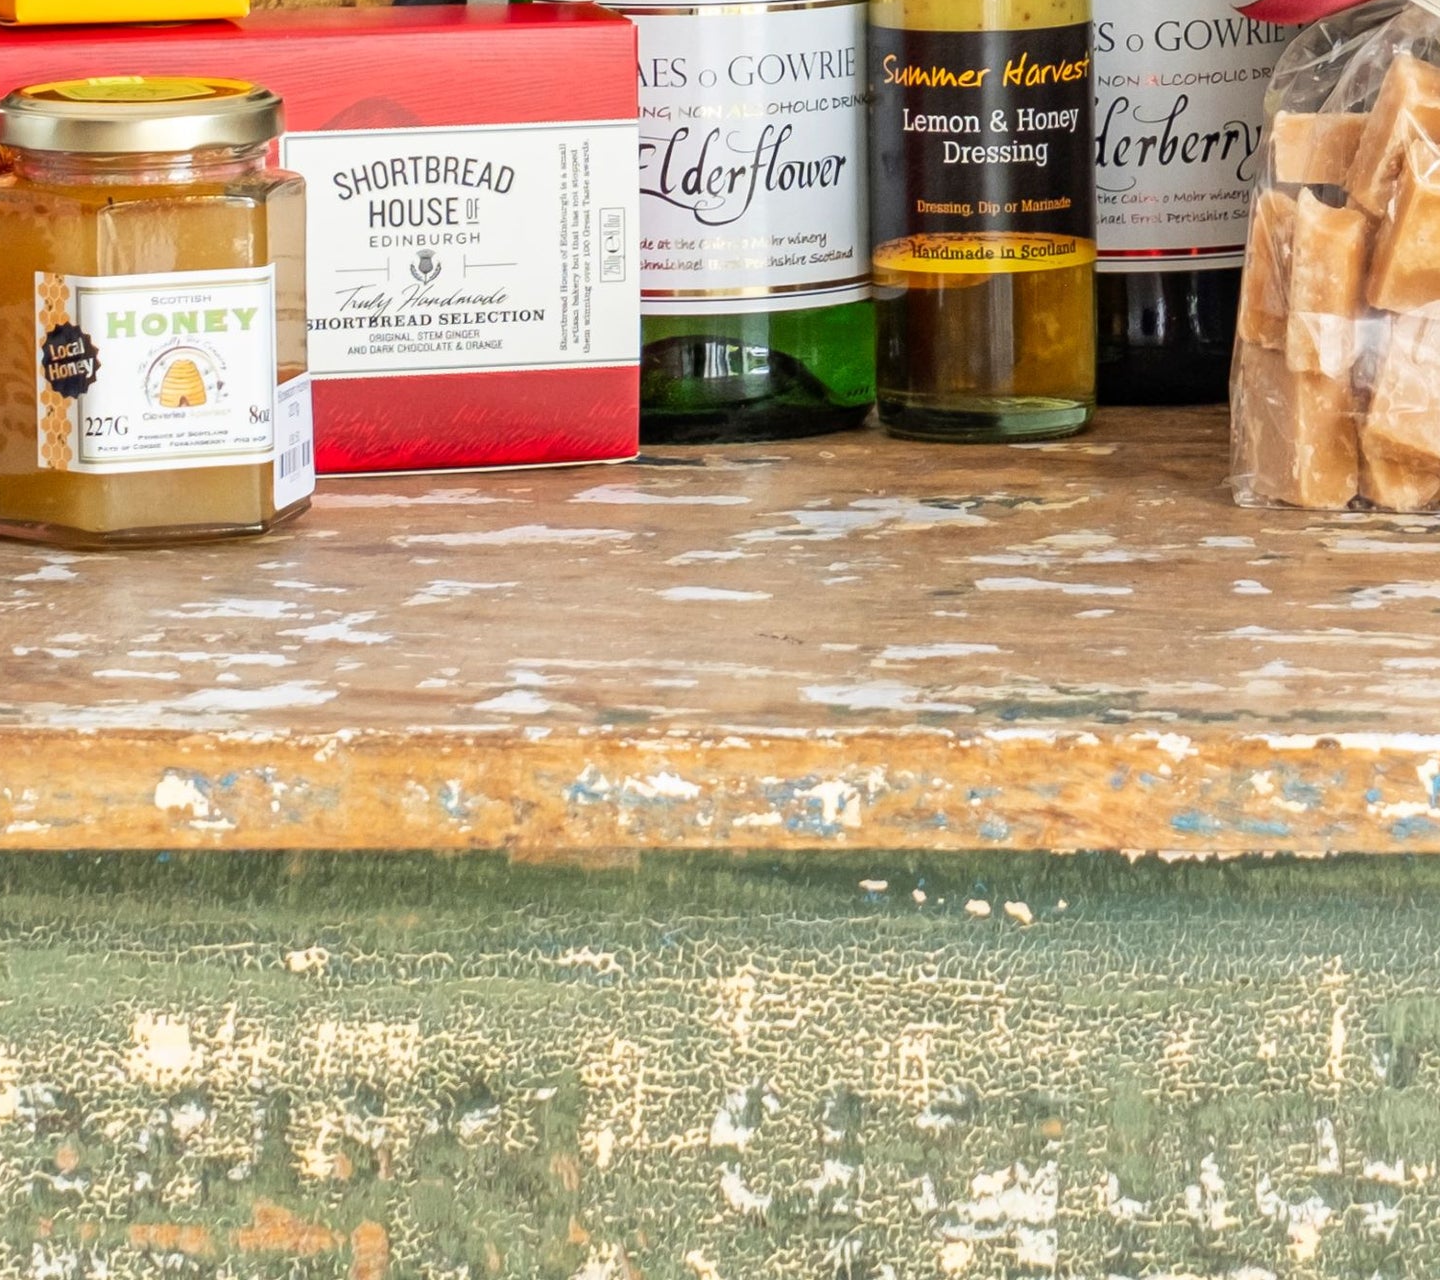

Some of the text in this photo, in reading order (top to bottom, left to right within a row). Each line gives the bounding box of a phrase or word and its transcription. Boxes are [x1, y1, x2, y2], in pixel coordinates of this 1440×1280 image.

[1155, 18, 1285, 52] GOWRIE
[728, 47, 856, 87] GOWRIE
[883, 51, 1090, 87] Summer Harvest
[1098, 75, 1140, 87] NON
[903, 108, 1079, 133] Lemon & Honey
[943, 140, 1048, 167] Dressing
[333, 155, 515, 200] SHORTBREAD
[582, 180, 590, 205] Taste
[369, 197, 479, 228] HOUSE OF
[978, 197, 1071, 216] Dip or Marinade
[369, 232, 480, 248] EDINBURGH
[912, 241, 1076, 260] Handmade in Scotland
[151, 294, 212, 305] SCOTTISH
[572, 274, 580, 306] bakery
[335, 284, 393, 324] Truly
[106, 307, 258, 338] HONEY
[307, 309, 545, 331] SHORTBREAD SELECTION
[560, 296, 568, 351] Shortbread
[50, 337, 85, 361] Local
[49, 358, 93, 381] Honey
[85, 415, 129, 437] 227G
[249, 405, 270, 425] 8oz
